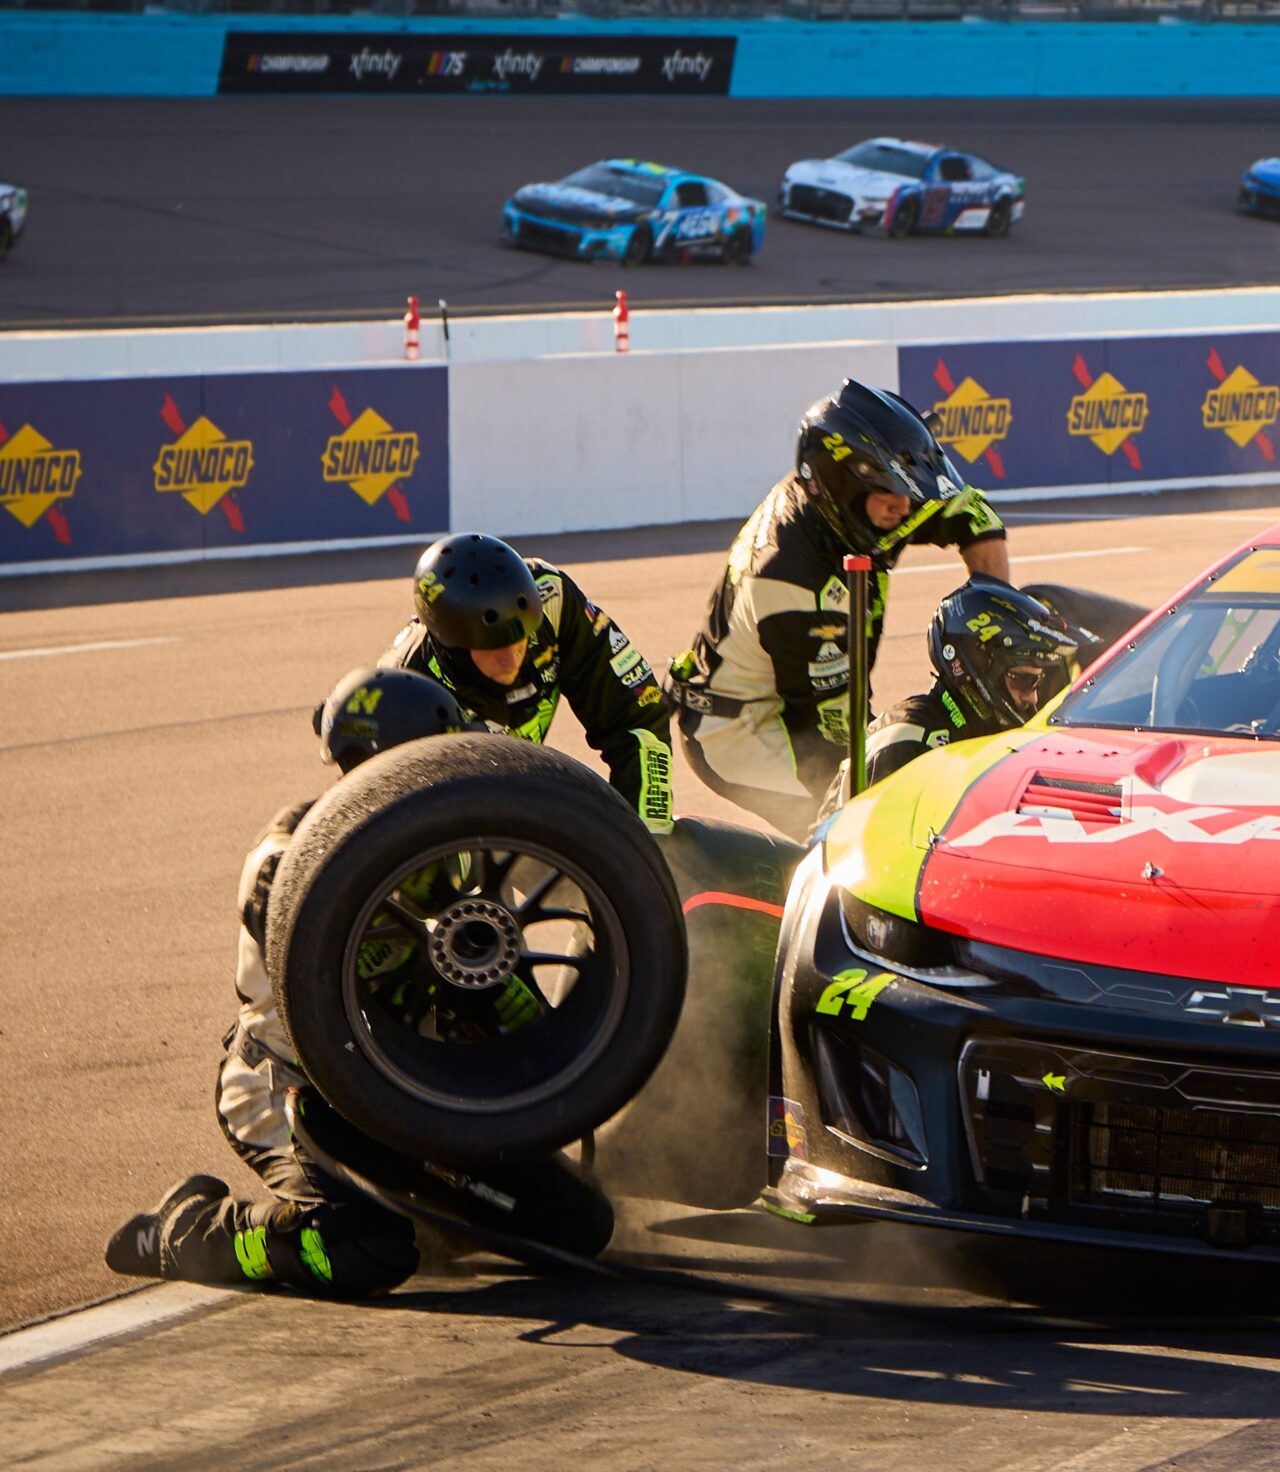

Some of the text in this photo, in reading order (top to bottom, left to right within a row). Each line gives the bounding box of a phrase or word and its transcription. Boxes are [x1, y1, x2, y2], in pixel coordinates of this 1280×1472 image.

[350, 48, 401, 80] xfinity
[493, 49, 544, 81] xfinity
[660, 50, 713, 81] xfinity
[935, 404, 1008, 438] SUNOCO
[1073, 397, 1144, 430] SUNOCO
[1206, 390, 1277, 424] SUNOCO
[325, 437, 415, 477] SUNOCO
[822, 432, 853, 462] 24
[0, 455, 77, 496] UNOCO
[158, 445, 251, 487] SUNOCO
[418, 571, 446, 603] 24
[966, 612, 1002, 643] 24
[647, 750, 668, 820] RAPTOR
[816, 968, 897, 1021] 24
